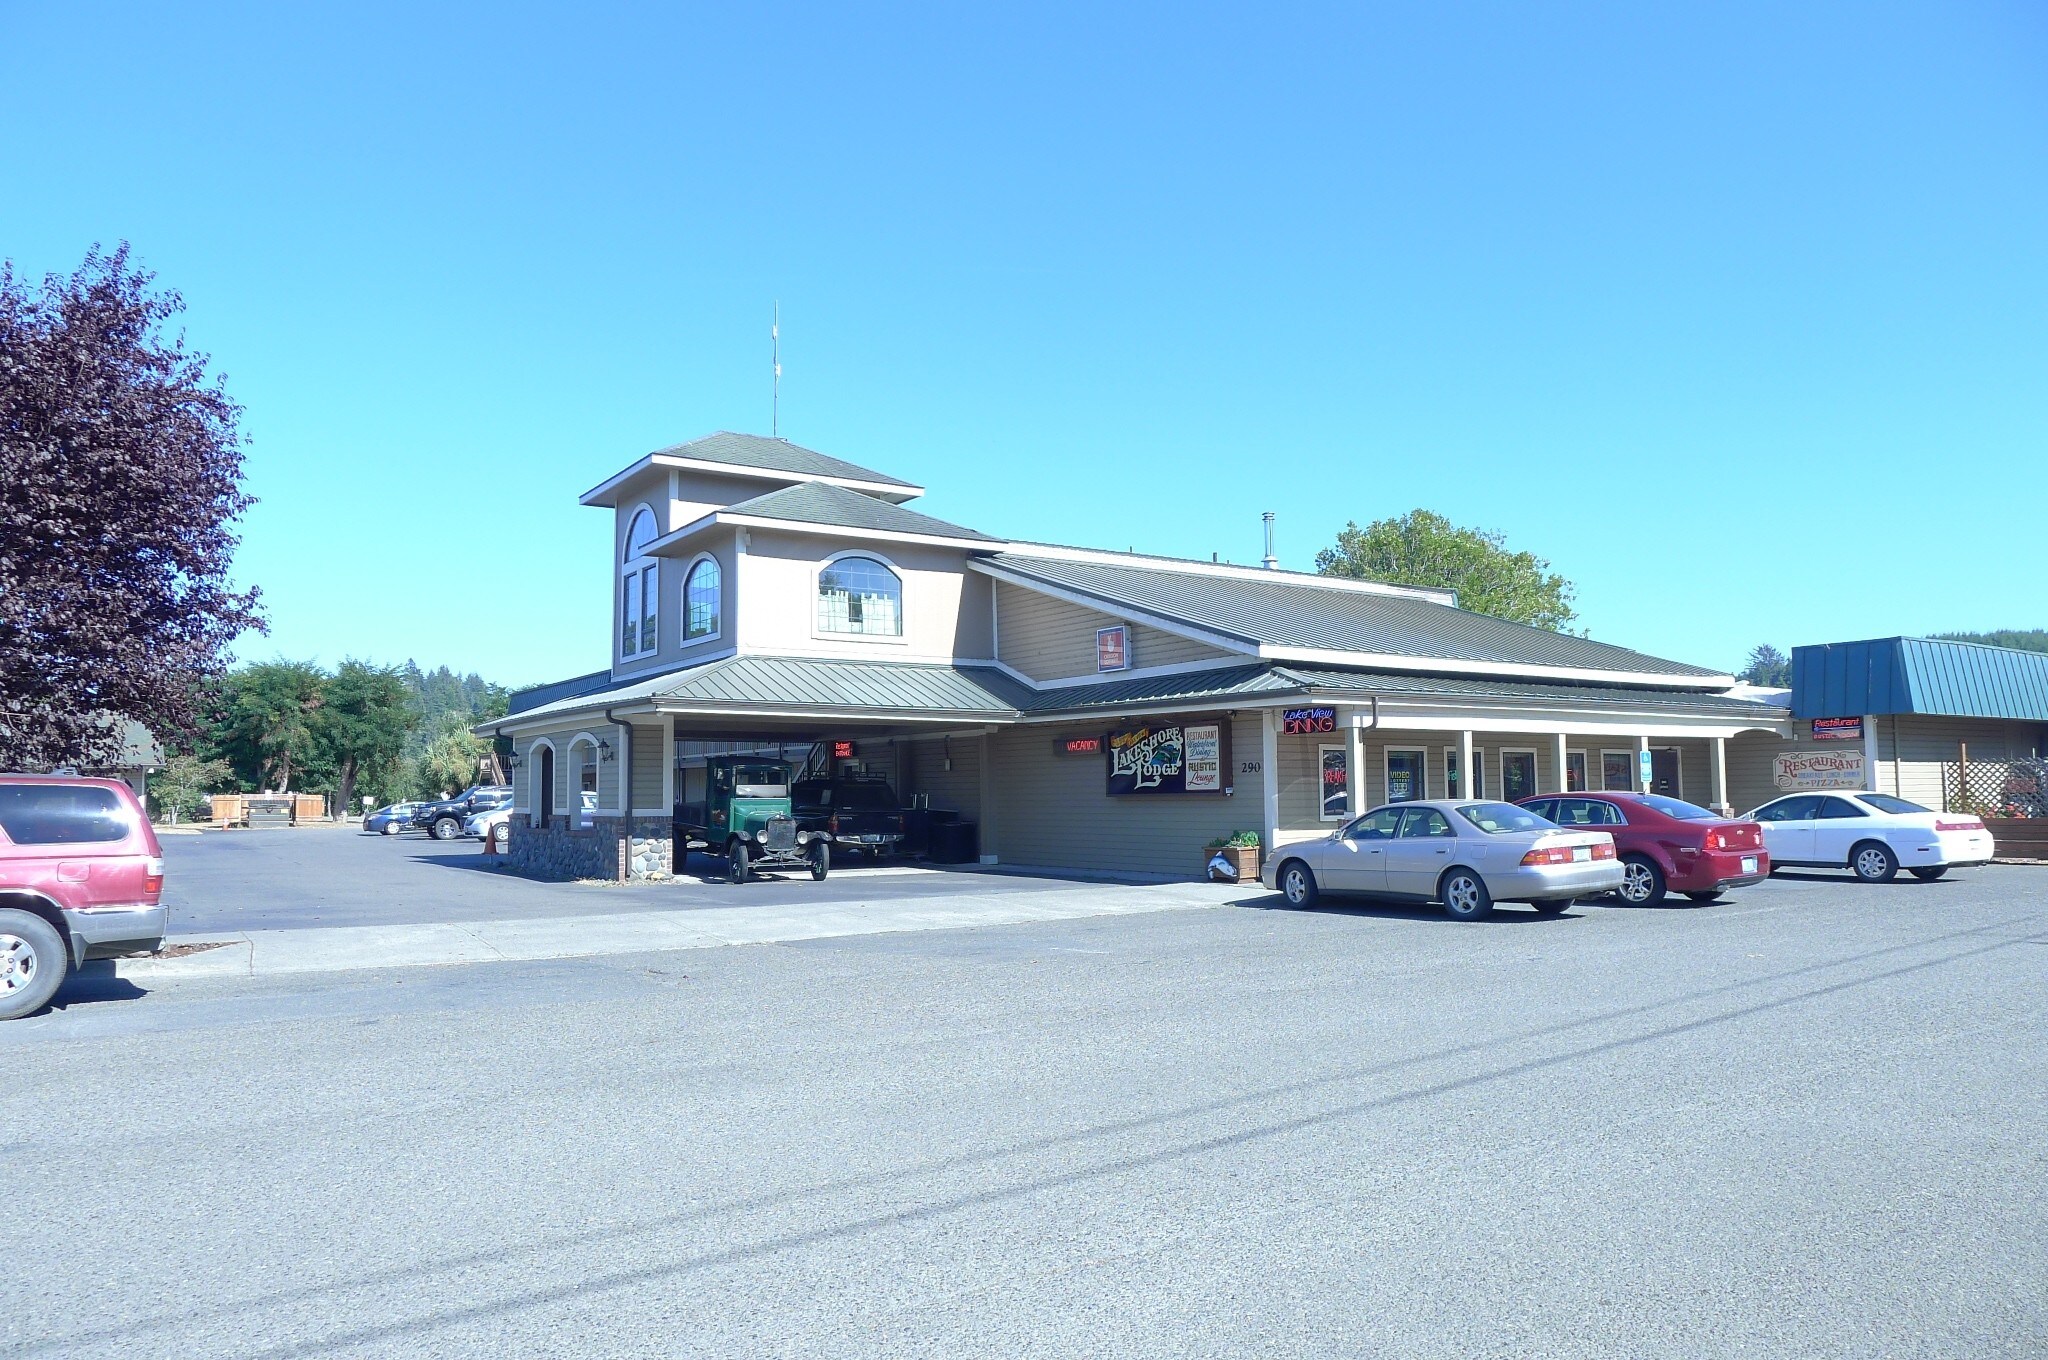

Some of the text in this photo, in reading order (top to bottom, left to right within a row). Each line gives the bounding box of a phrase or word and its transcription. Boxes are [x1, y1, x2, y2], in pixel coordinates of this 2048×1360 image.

[1283, 708, 1333, 720] Lake View
[1284, 717, 1334, 735] DINING
[1815, 718, 1860, 727] Restaurant
[1186, 730, 1217, 740] RESTAURANT
[1067, 740, 1098, 751] VACANCY
[1188, 761, 1217, 772] RUSTIC
[1241, 761, 1261, 773] 290
[1779, 757, 1861, 777] RESTAURANT
[1134, 760, 1181, 790] LODGE
[1187, 771, 1216, 786] Lounge
[1390, 770, 1411, 779] VIDEO
[1810, 778, 1840, 787] PIZZA
